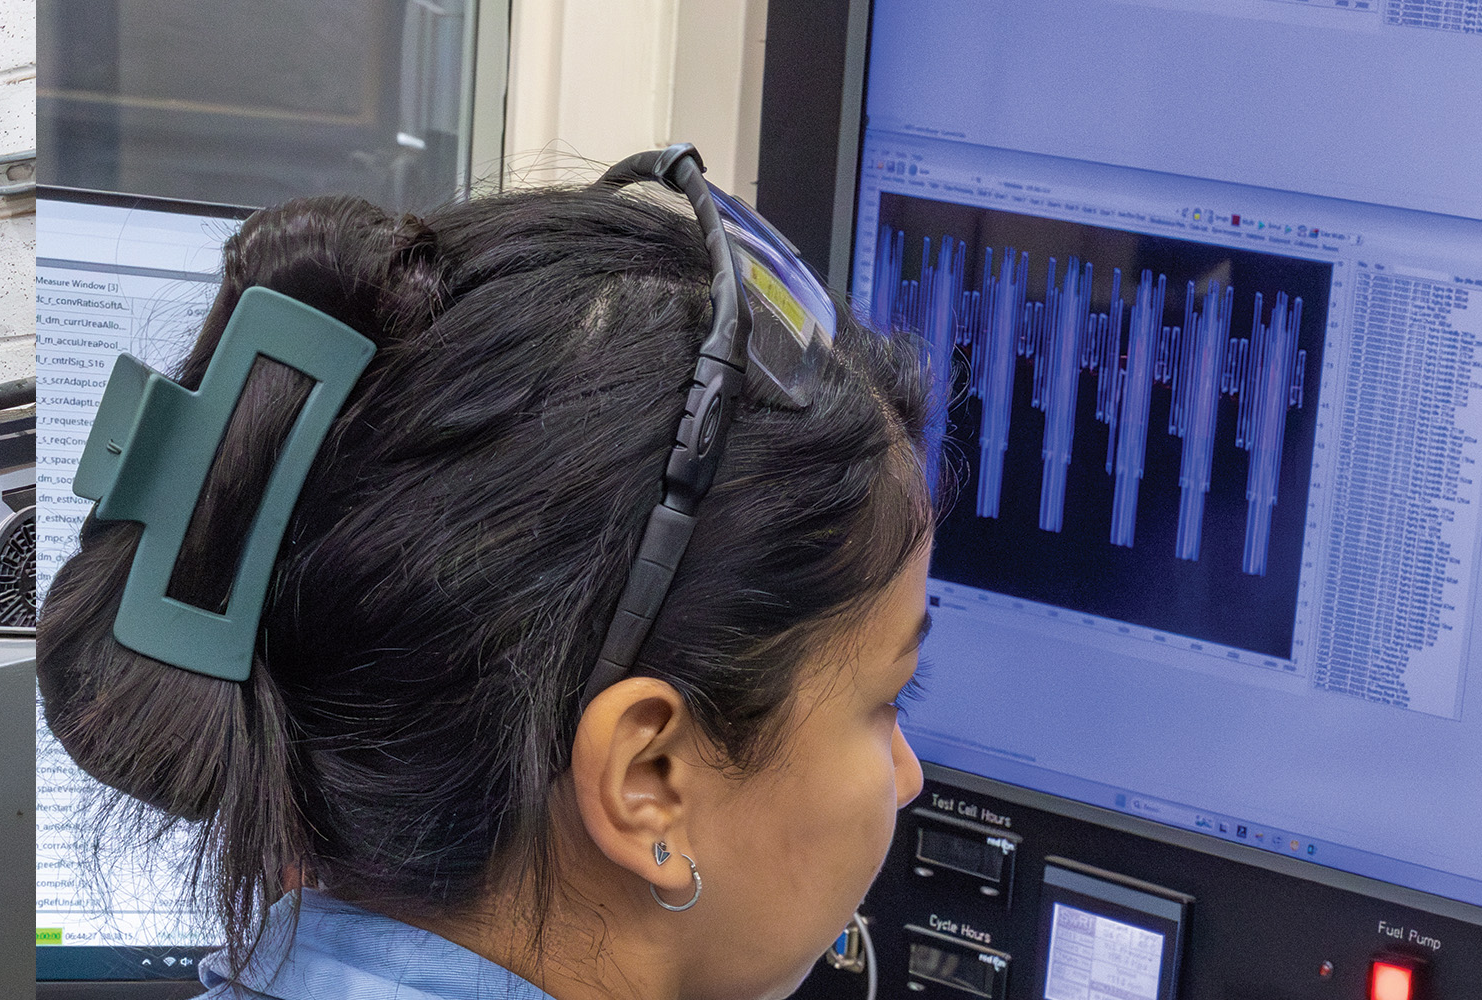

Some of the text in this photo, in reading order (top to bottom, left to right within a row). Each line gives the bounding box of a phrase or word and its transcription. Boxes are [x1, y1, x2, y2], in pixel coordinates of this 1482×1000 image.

[36, 276, 70, 287] Measure
[72, 280, 105, 290] Window
[932, 793, 1012, 827] Test Cell Hours
[929, 914, 991, 943] Cycle Hours
[1378, 921, 1441, 951] Fuel Pump
